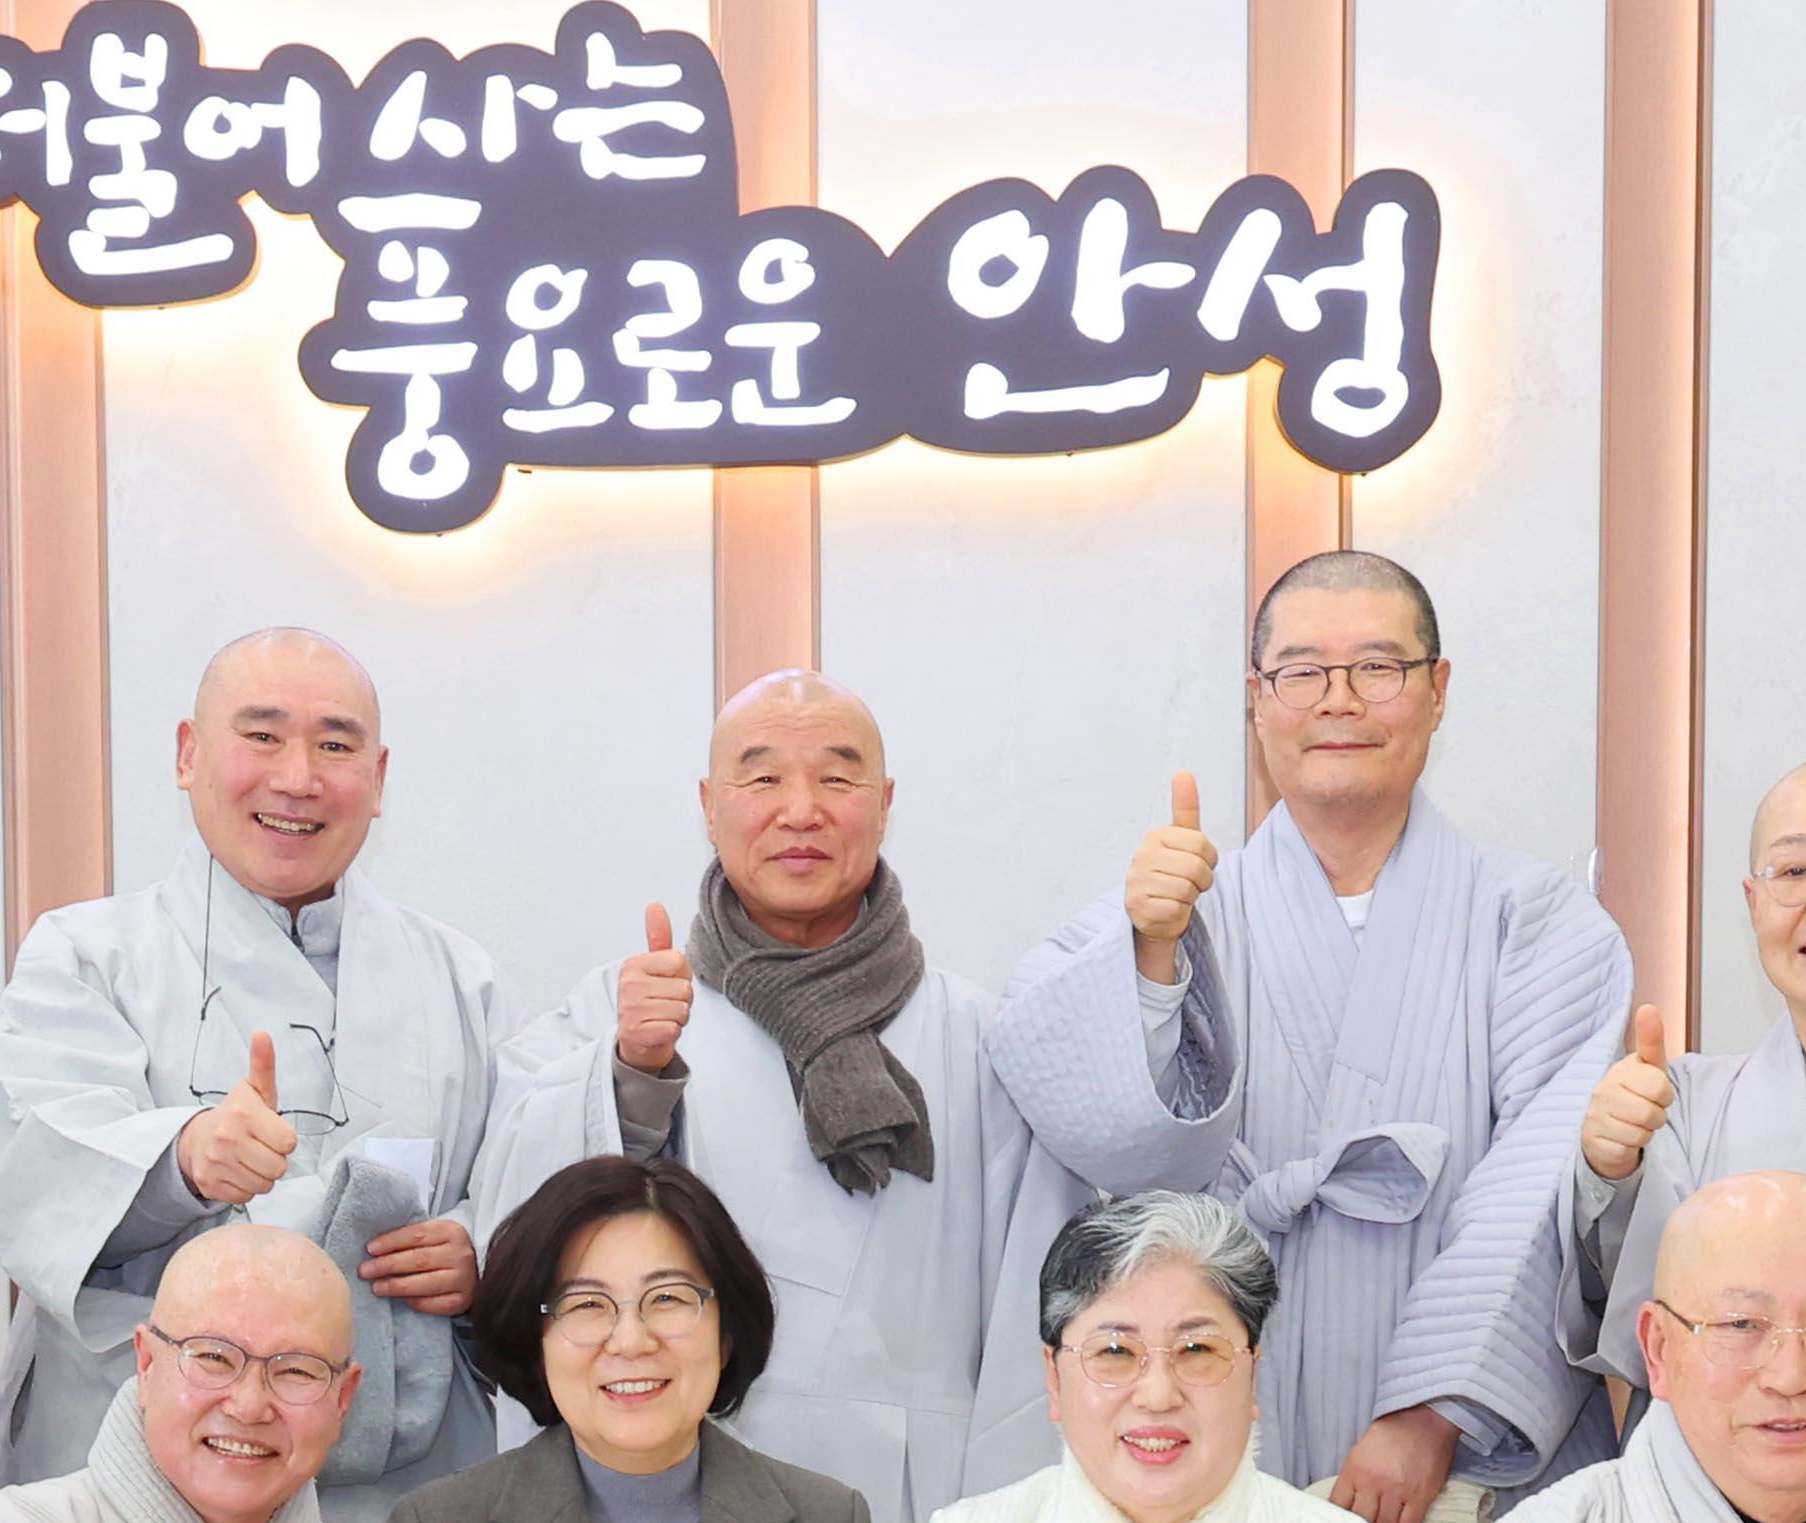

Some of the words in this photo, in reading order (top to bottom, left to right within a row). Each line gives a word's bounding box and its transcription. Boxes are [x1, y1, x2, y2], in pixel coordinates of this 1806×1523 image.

[368, 32, 707, 180] 사는
[331, 193, 858, 500] 풍요로운
[947, 198, 1410, 438] 안성
